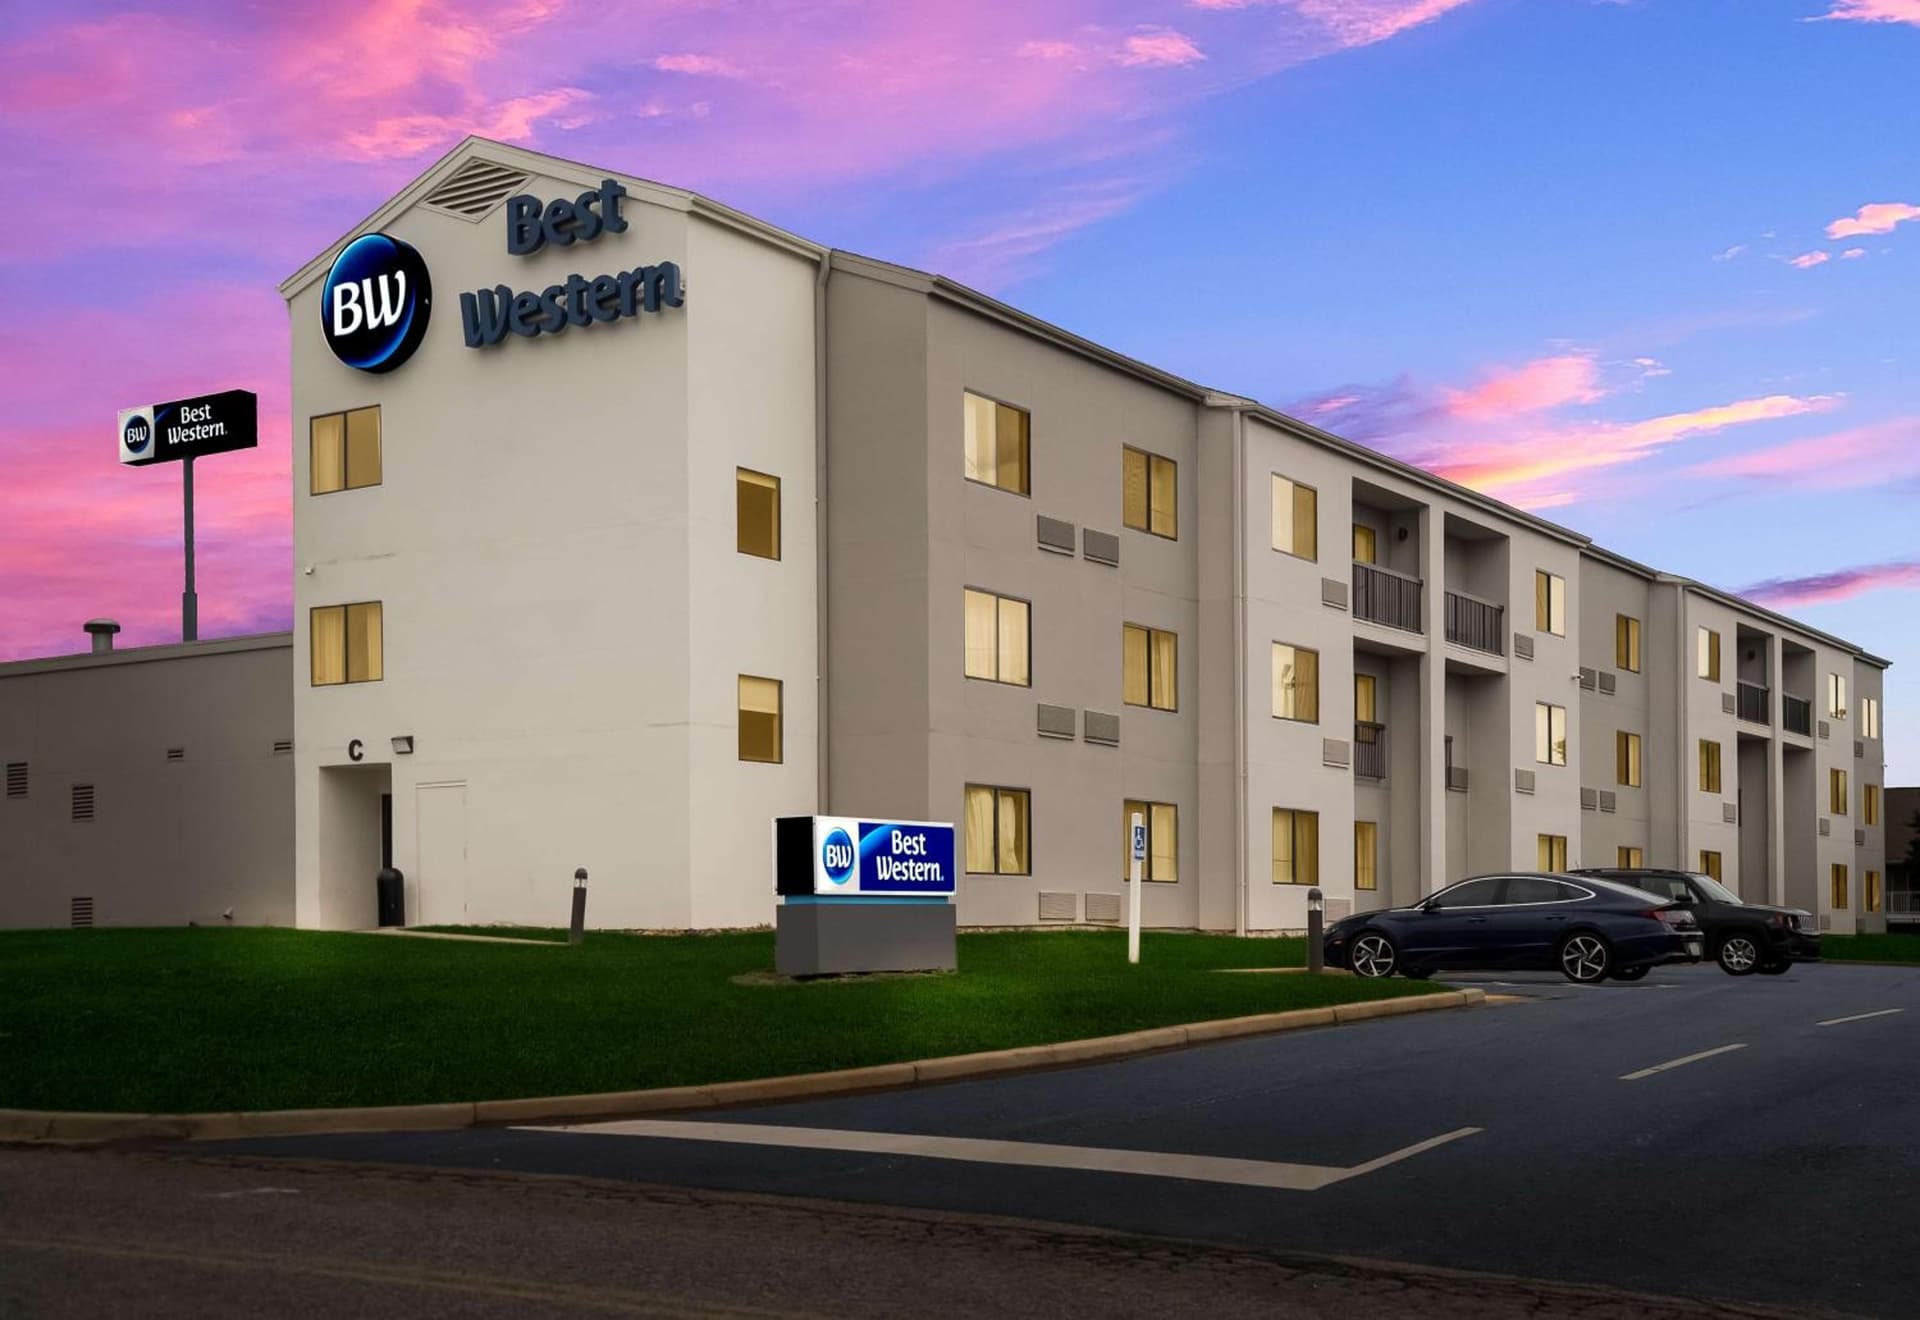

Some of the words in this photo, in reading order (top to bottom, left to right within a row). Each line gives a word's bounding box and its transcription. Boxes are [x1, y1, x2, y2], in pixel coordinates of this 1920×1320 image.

[506, 179, 628, 256] Best
[332, 269, 406, 337] BW
[459, 260, 684, 348] Western
[180, 403, 212, 424] Best
[126, 425, 147, 443] BW
[167, 422, 225, 445] Western
[348, 739, 364, 762] C
[891, 829, 927, 855] Best
[825, 844, 851, 868] BW
